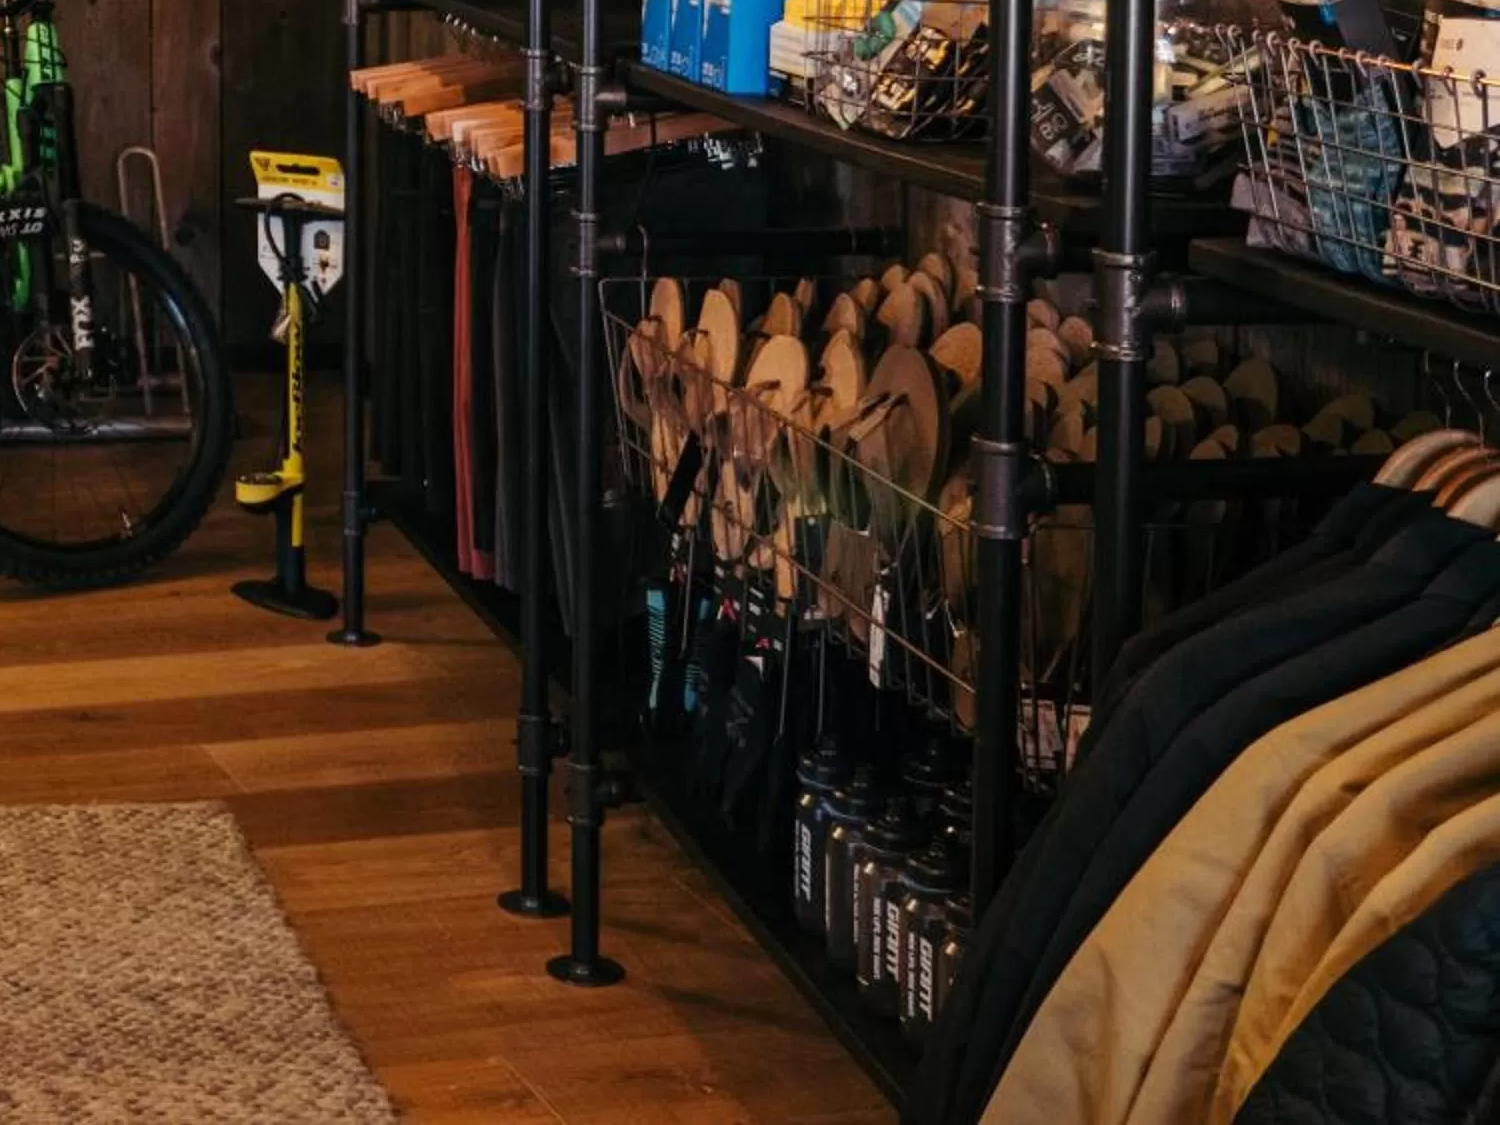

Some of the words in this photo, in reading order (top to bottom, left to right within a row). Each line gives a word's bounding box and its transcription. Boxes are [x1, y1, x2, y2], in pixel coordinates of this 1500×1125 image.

[69, 295, 96, 351] FOX
[800, 823, 813, 904] GIANT
[885, 901, 900, 984] GIANT
[918, 937, 934, 1023] GIANT
